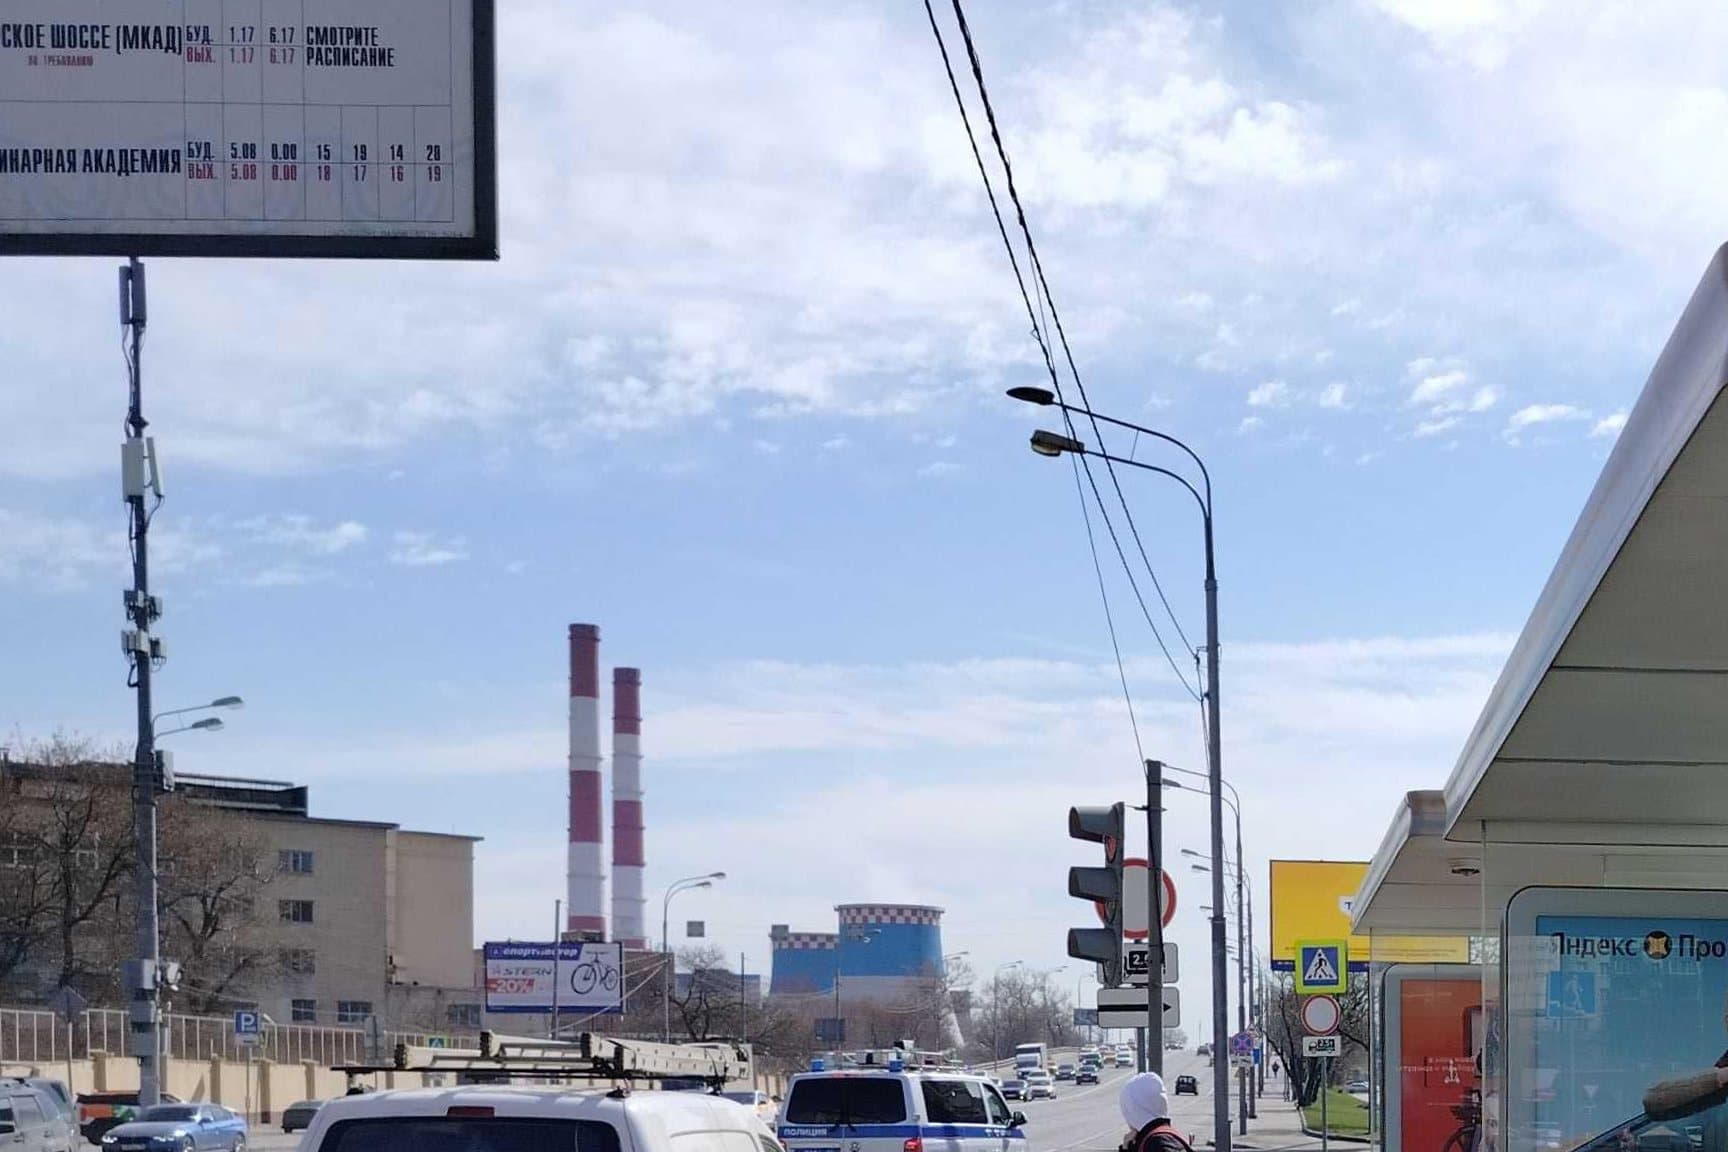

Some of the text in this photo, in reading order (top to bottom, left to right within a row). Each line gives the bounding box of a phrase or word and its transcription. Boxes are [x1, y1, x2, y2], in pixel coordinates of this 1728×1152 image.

[1, 24, 182, 55] СКОЕ ШОССЕ (МКАД)
[185, 26, 295, 44] БУД. 1.17 6.17
[306, 26, 379, 47] СМОТРИТЕ
[230, 48, 255, 64] 1.17
[306, 47, 395, 68] РАСПИСАНИЕ
[187, 141, 216, 161] БУД.
[316, 144, 331, 161] 15
[353, 144, 367, 161] 19
[389, 144, 404, 161] 14
[82, 148, 181, 176] АКАДЕМИЯ
[353, 165, 367, 182] 17
[1546, 931, 1727, 961] Яндекс Про
